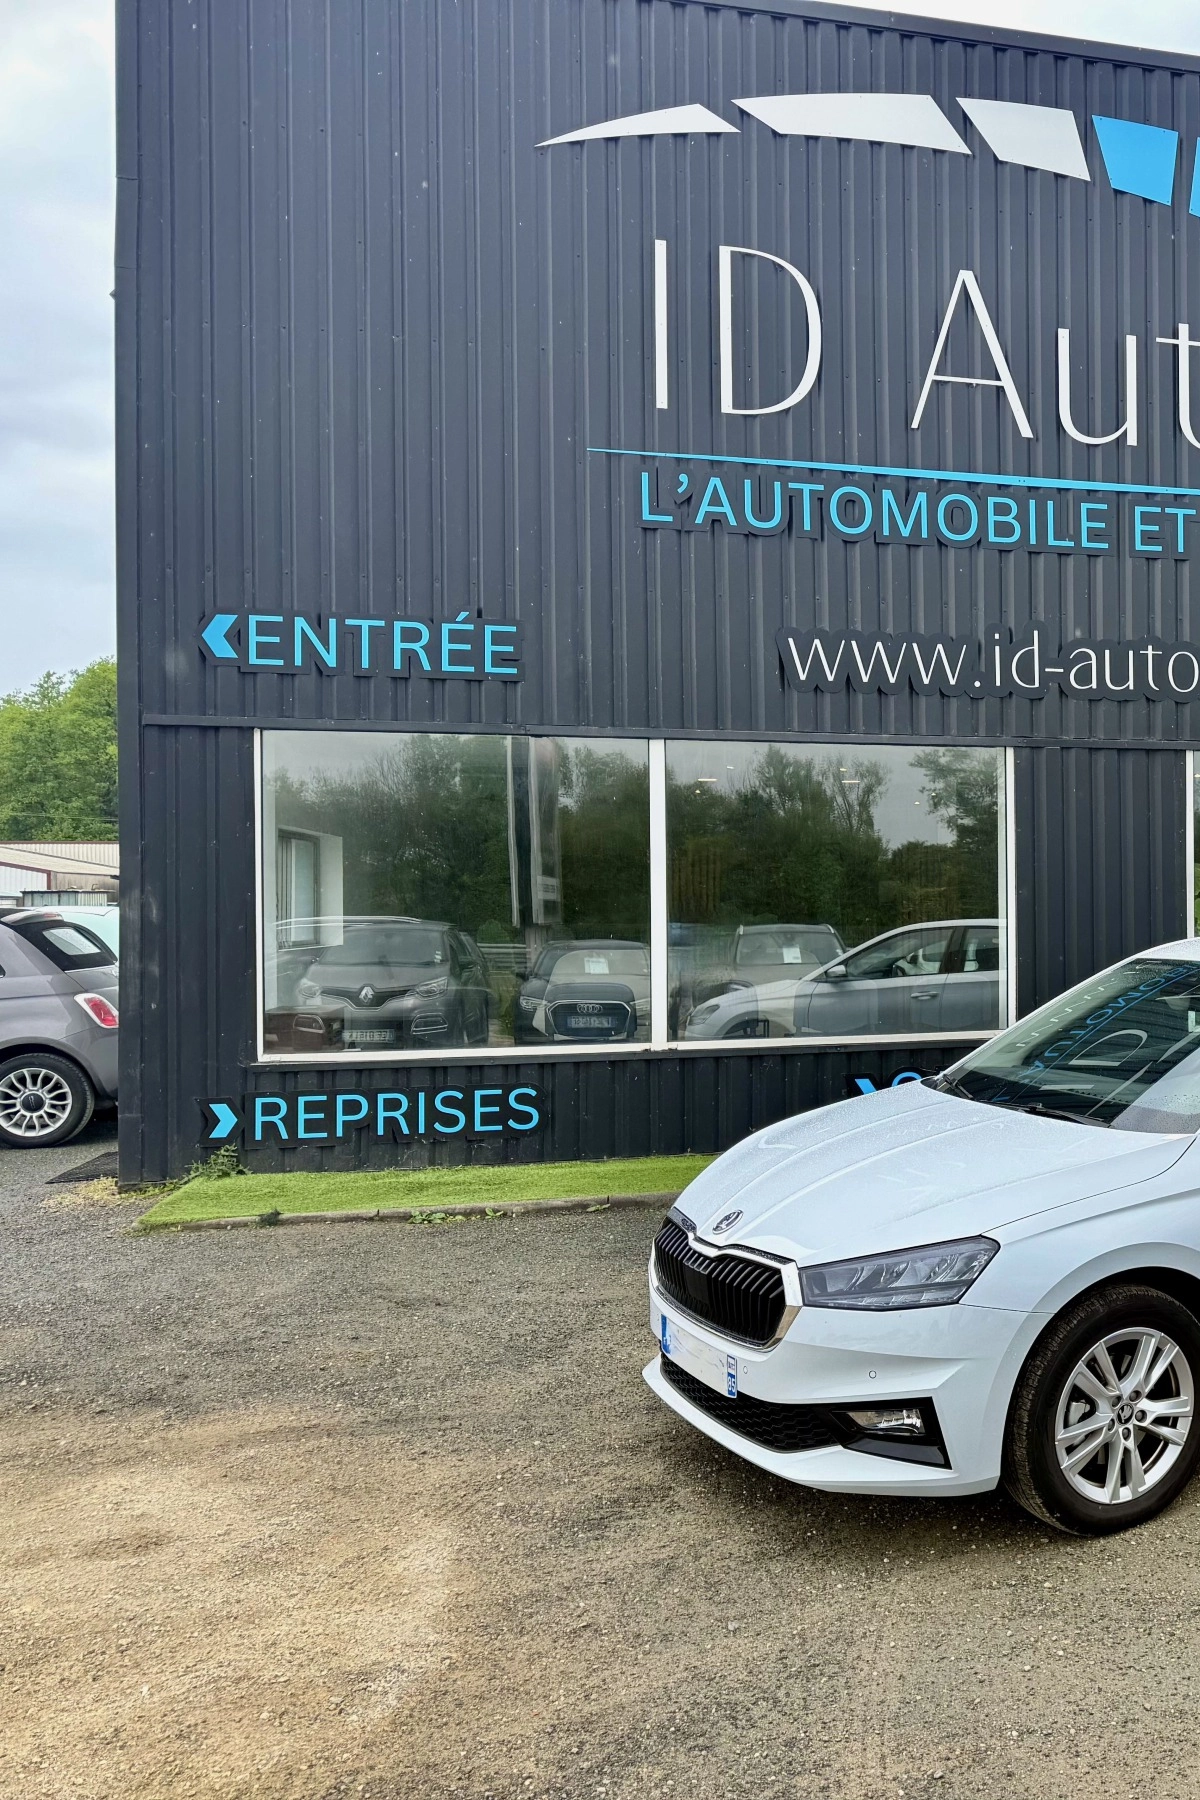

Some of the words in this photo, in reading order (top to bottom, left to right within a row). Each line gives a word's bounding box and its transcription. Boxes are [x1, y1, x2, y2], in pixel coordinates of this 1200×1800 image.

[655, 239, 822, 415] ID
[641, 471, 1111, 549] L'AUTOMOBILE
[1134, 506, 1197, 553] ET
[247, 611, 518, 674] ENTRÉE
[254, 1087, 540, 1141] REPRISES
[728, 1376, 736, 1393] 85
